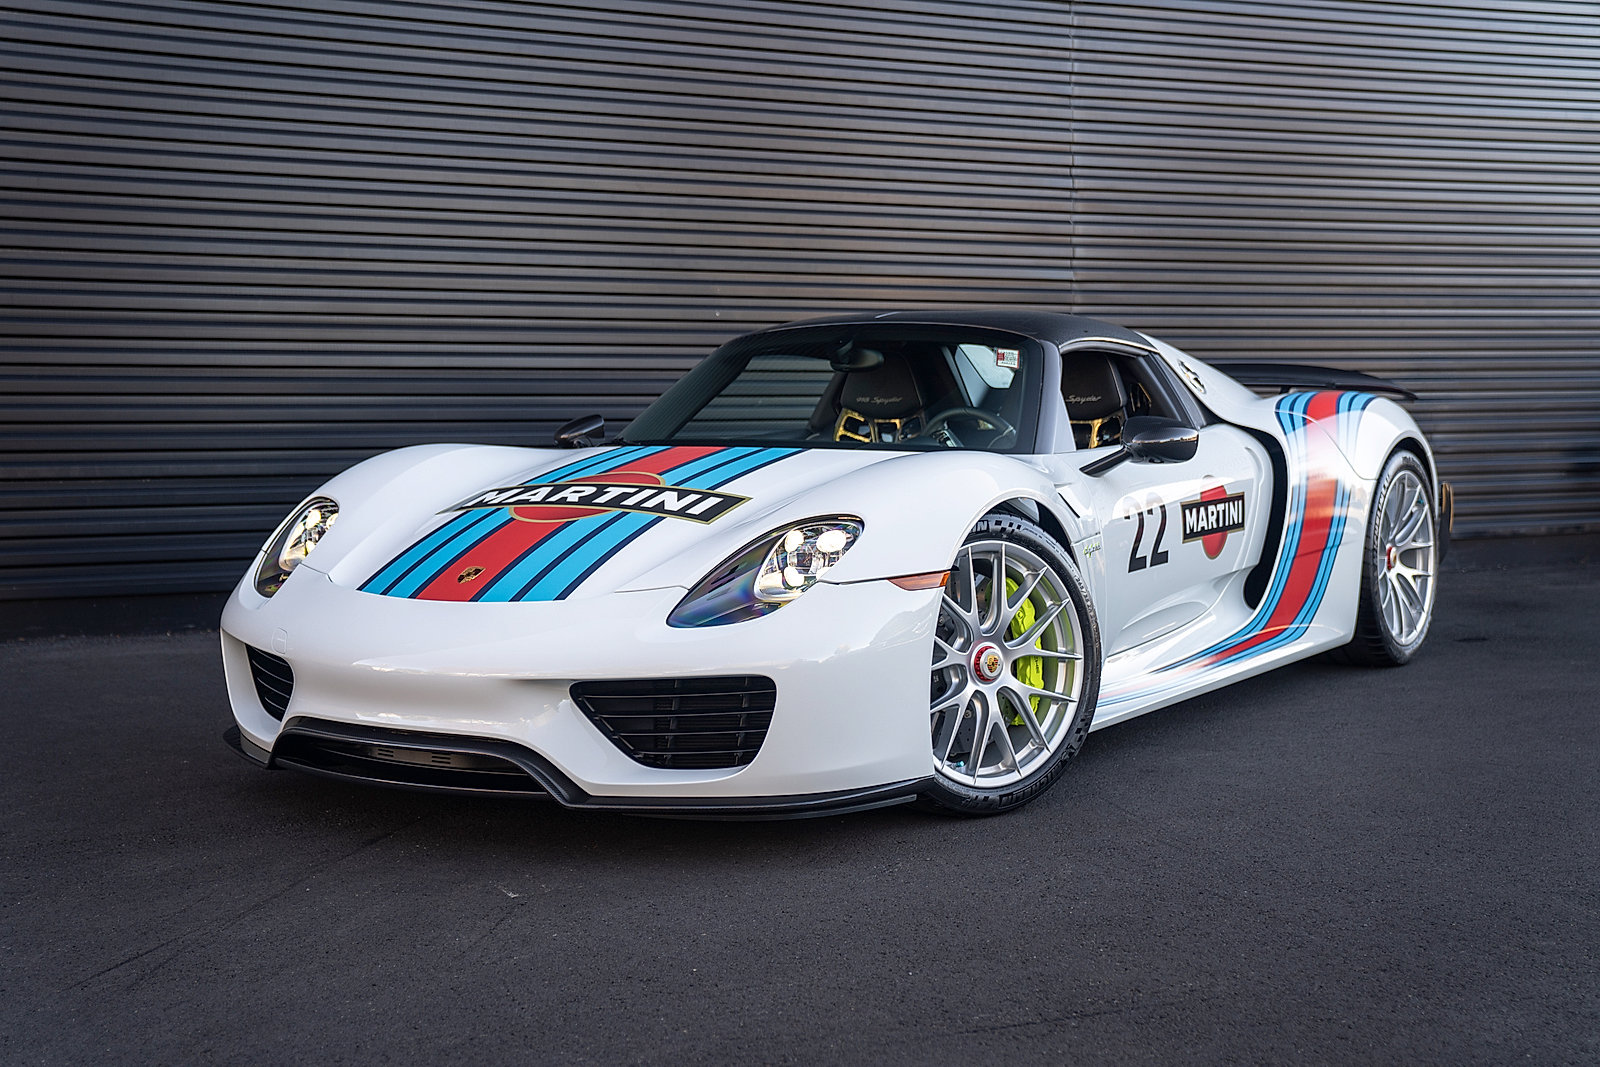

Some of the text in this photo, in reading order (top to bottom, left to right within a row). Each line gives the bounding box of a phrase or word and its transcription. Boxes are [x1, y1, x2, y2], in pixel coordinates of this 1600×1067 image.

[871, 396, 904, 405] Spyder
[1065, 394, 1102, 404] Spyder
[463, 485, 725, 516] MARTINI
[1123, 492, 1169, 574] 22
[1185, 500, 1243, 535] MARTINI
